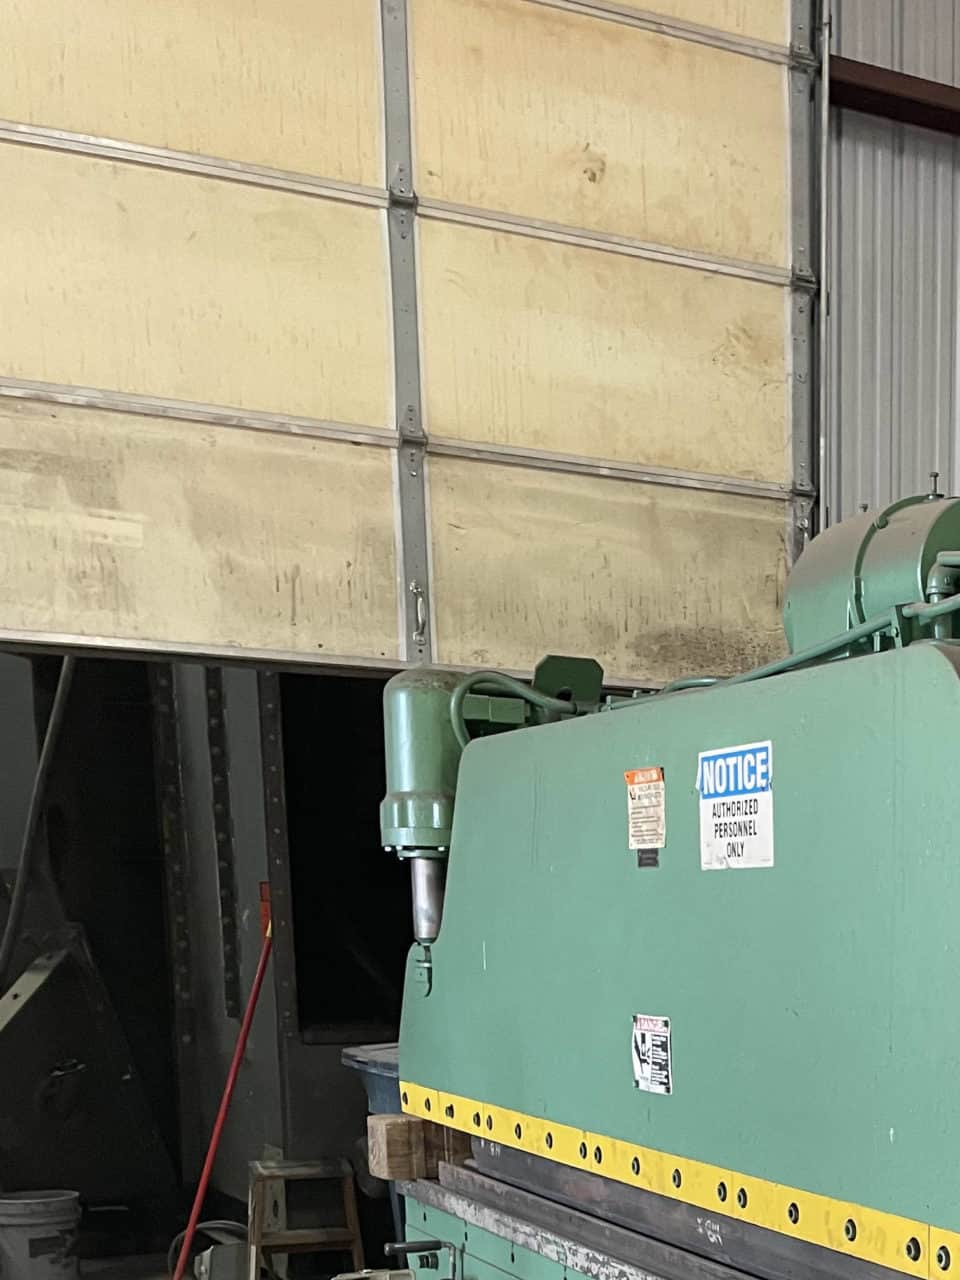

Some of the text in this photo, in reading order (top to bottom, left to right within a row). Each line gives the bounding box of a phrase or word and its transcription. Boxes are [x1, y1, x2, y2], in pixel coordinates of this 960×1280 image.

[703, 751, 767, 795] NOTICE
[712, 799, 759, 818] AUTHORIZED
[714, 820, 758, 839] PERSONNEL
[726, 841, 744, 858] ONLY
